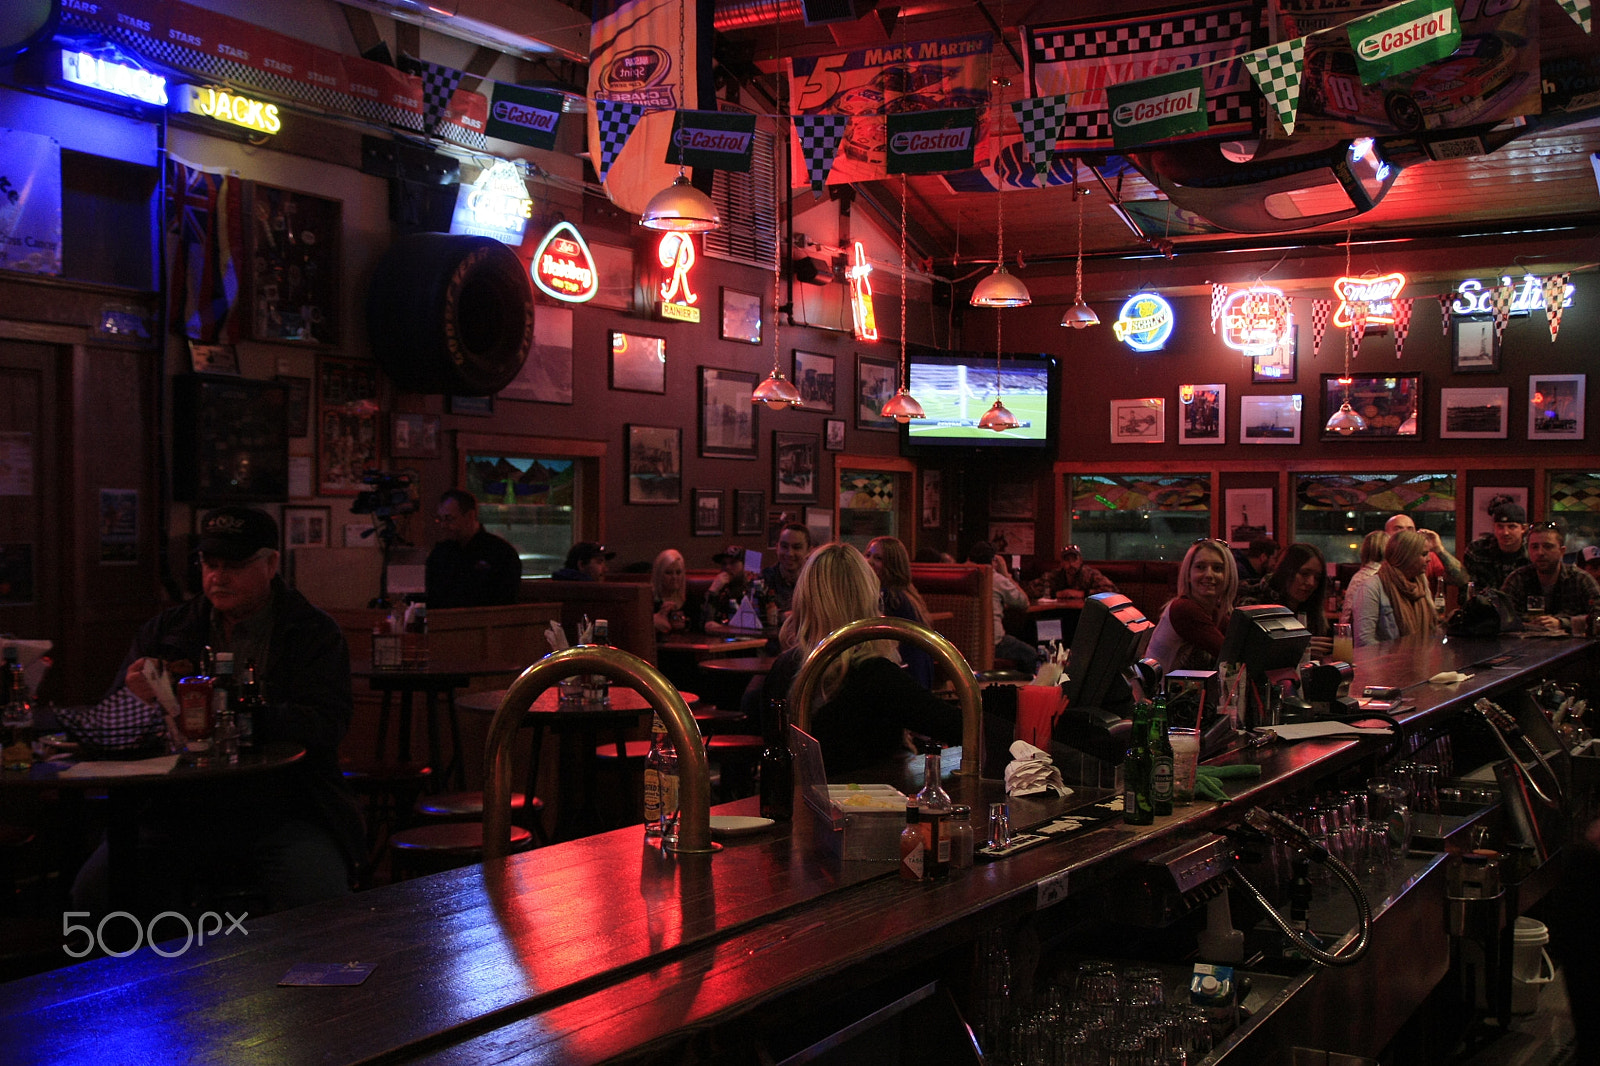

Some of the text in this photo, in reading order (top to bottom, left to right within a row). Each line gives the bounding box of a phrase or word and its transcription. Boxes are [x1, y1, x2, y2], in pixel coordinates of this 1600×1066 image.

[1379, 14, 1446, 53] Castrol
[864, 39, 984, 67] MARK MARTIN
[78, 52, 169, 104] BLACK
[117, 13, 151, 32] STARS
[168, 28, 202, 46] STARS
[217, 43, 249, 60] STARS
[263, 57, 294, 74] STARS
[307, 70, 336, 86] STARS
[350, 82, 379, 98] STARS
[392, 93, 419, 109] STARS
[461, 115, 484, 130] STARS
[797, 53, 848, 111] 5
[1134, 92, 1193, 121] Castrol
[1327, 75, 1361, 112] 18
[200, 88, 282, 132] JACKS
[507, 104, 553, 129] Castrol
[691, 131, 746, 151] Castrol
[909, 129, 966, 152] Castrol
[1343, 281, 1399, 302] Miller
[664, 304, 692, 319] RAINIER
